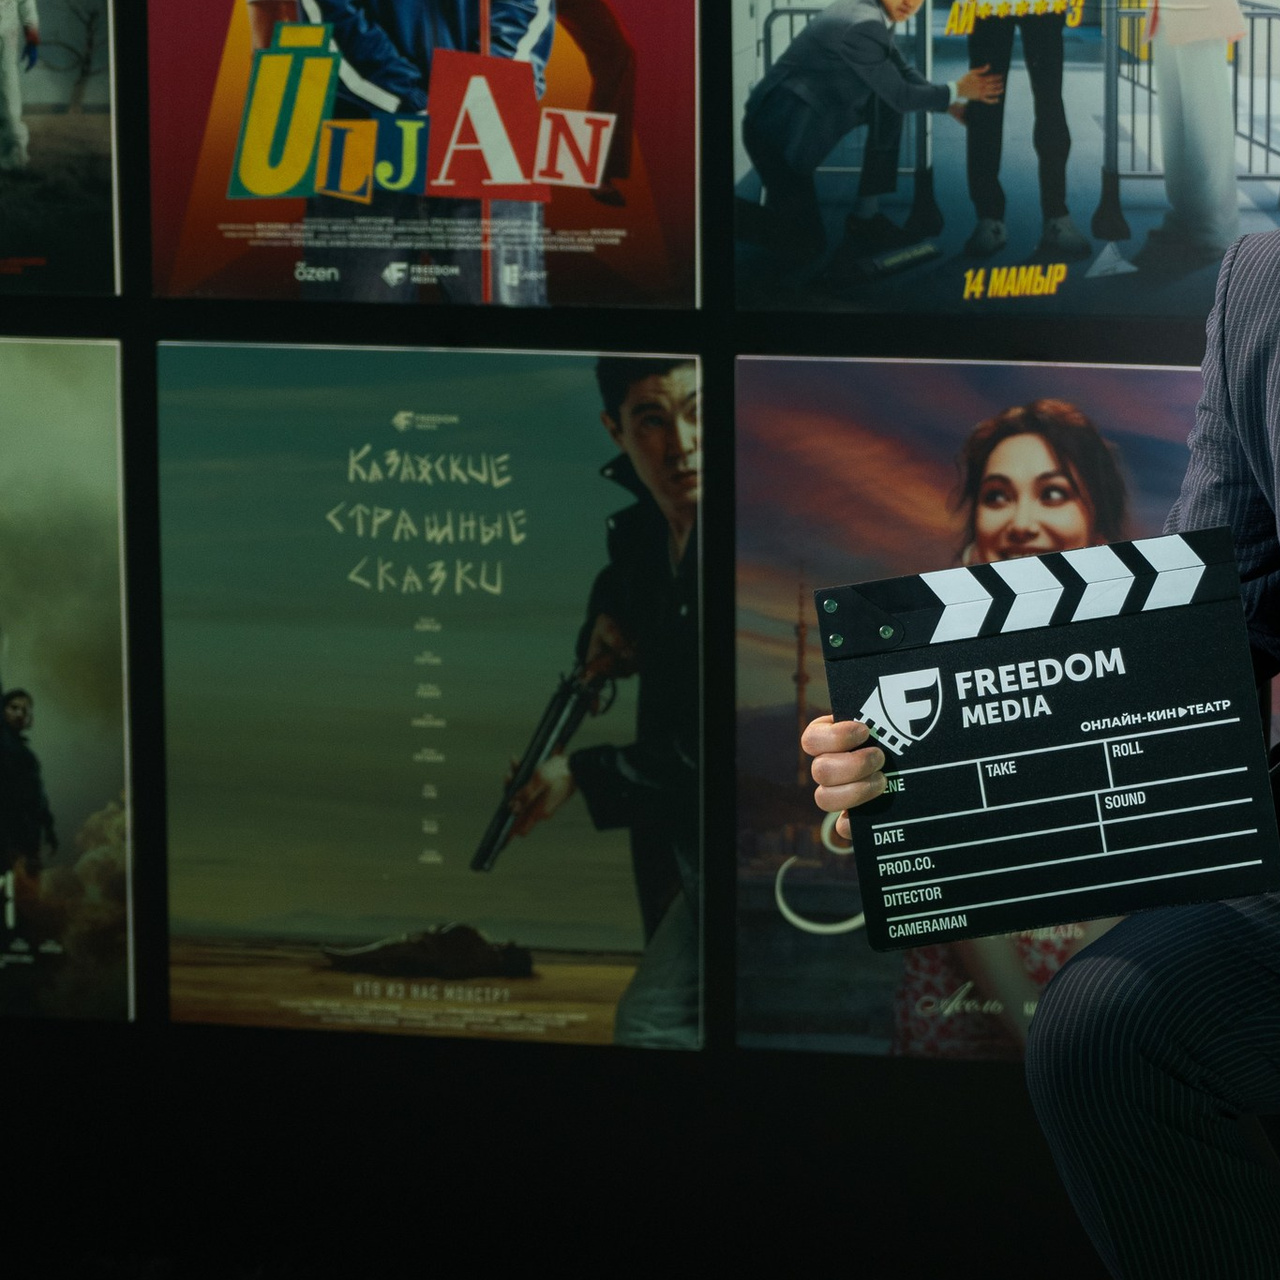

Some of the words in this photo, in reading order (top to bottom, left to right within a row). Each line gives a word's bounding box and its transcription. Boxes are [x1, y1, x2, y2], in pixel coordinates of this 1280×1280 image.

[963, 268, 985, 300] 14
[987, 263, 1068, 299] МАМЫР
[954, 647, 1127, 700] FREEDOM
[962, 694, 1052, 728] MEDIA
[1111, 741, 1144, 758] ROLL
[985, 760, 1018, 777] TAKE
[1104, 791, 1147, 810] SOUND
[873, 828, 905, 846] DATE
[878, 856, 936, 877] PROD.CO.
[883, 887, 942, 908] DITECTOR
[888, 914, 968, 939] CAMERAMAN
